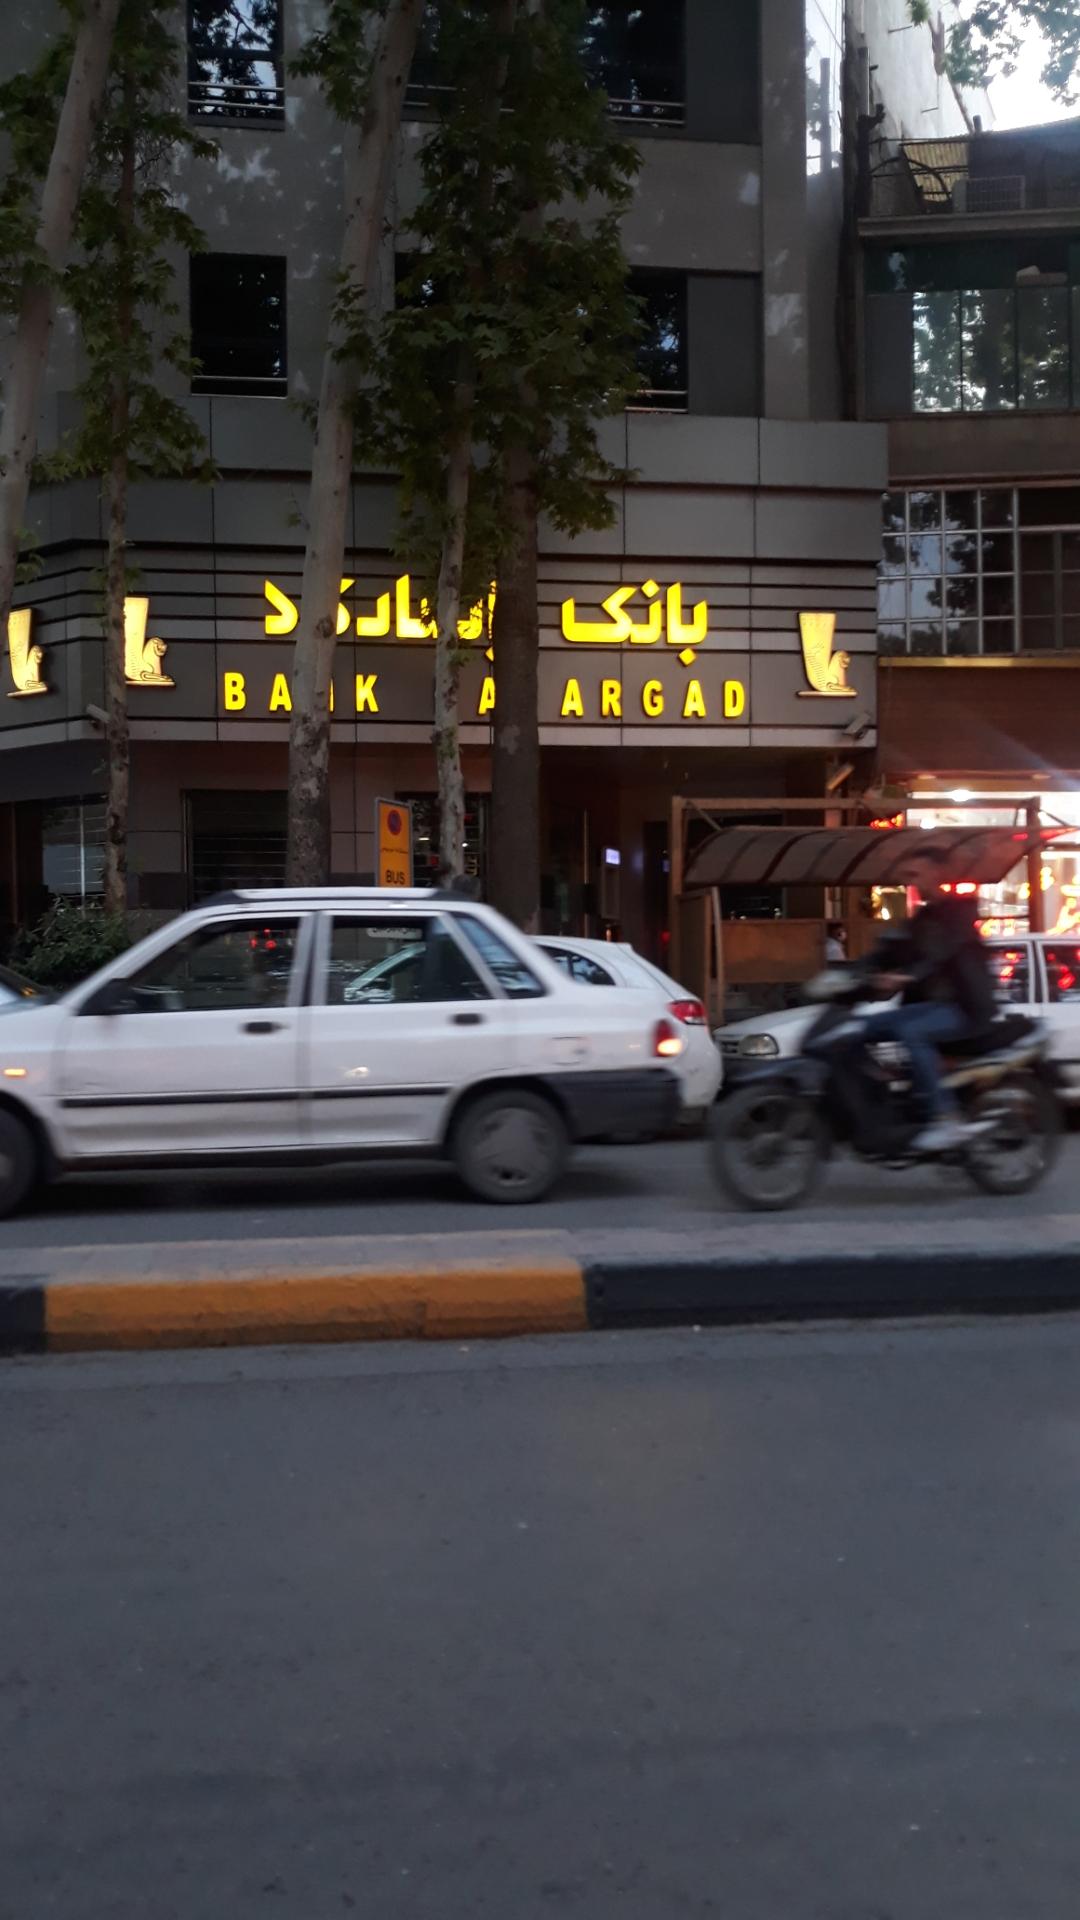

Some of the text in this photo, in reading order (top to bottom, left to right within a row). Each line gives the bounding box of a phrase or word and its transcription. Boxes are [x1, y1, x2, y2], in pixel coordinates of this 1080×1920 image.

[561, 578, 709, 667] بانک
[224, 672, 380, 712] BAK
[385, 869, 406, 885] BUS
